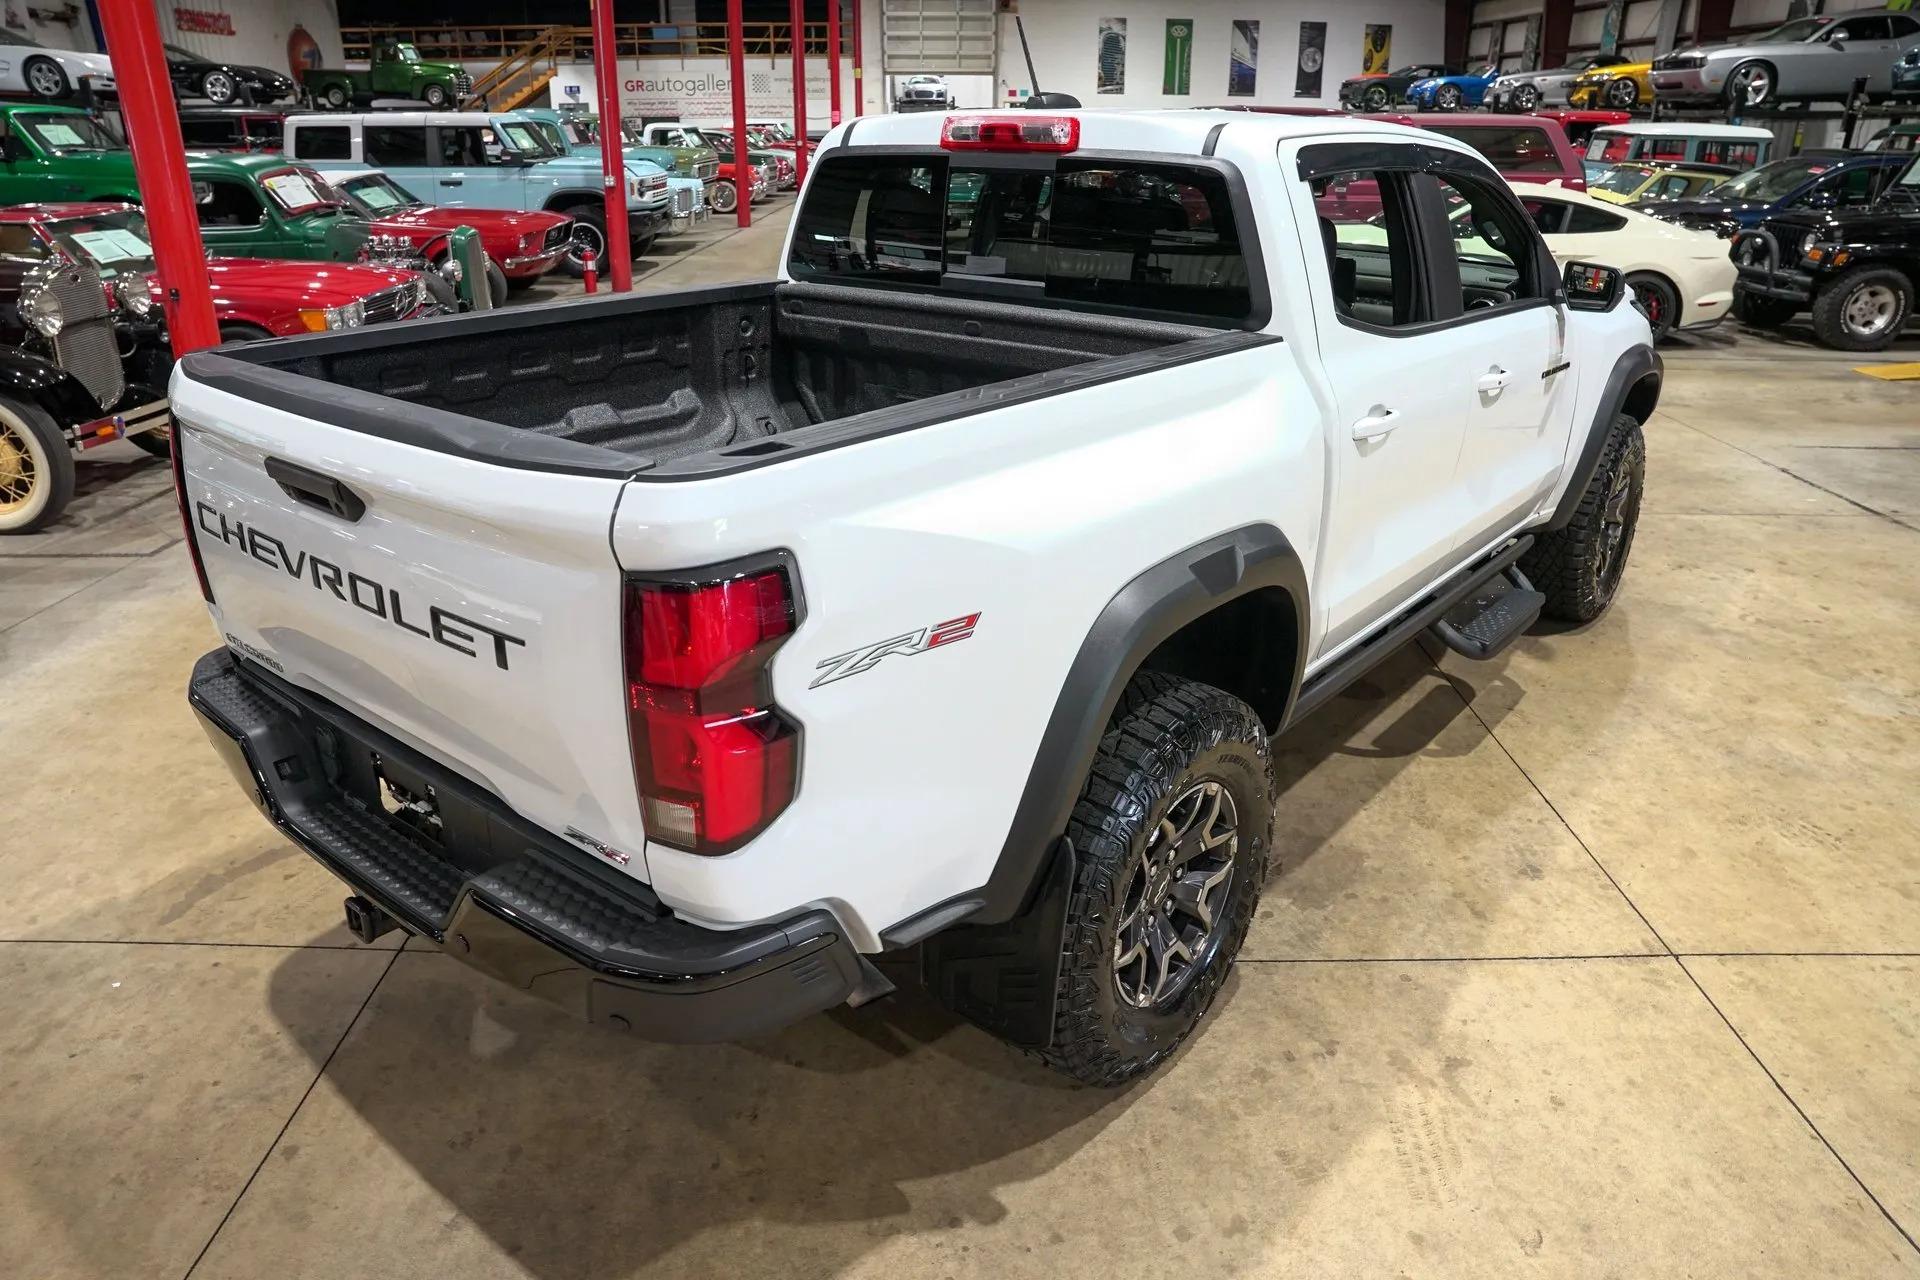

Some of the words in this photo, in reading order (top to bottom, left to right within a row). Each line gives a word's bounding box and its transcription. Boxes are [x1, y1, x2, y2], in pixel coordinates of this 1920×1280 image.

[624, 73, 732, 97] GRautogaller
[196, 500, 526, 671] CHEVROLET
[808, 611, 982, 690] ZR2
